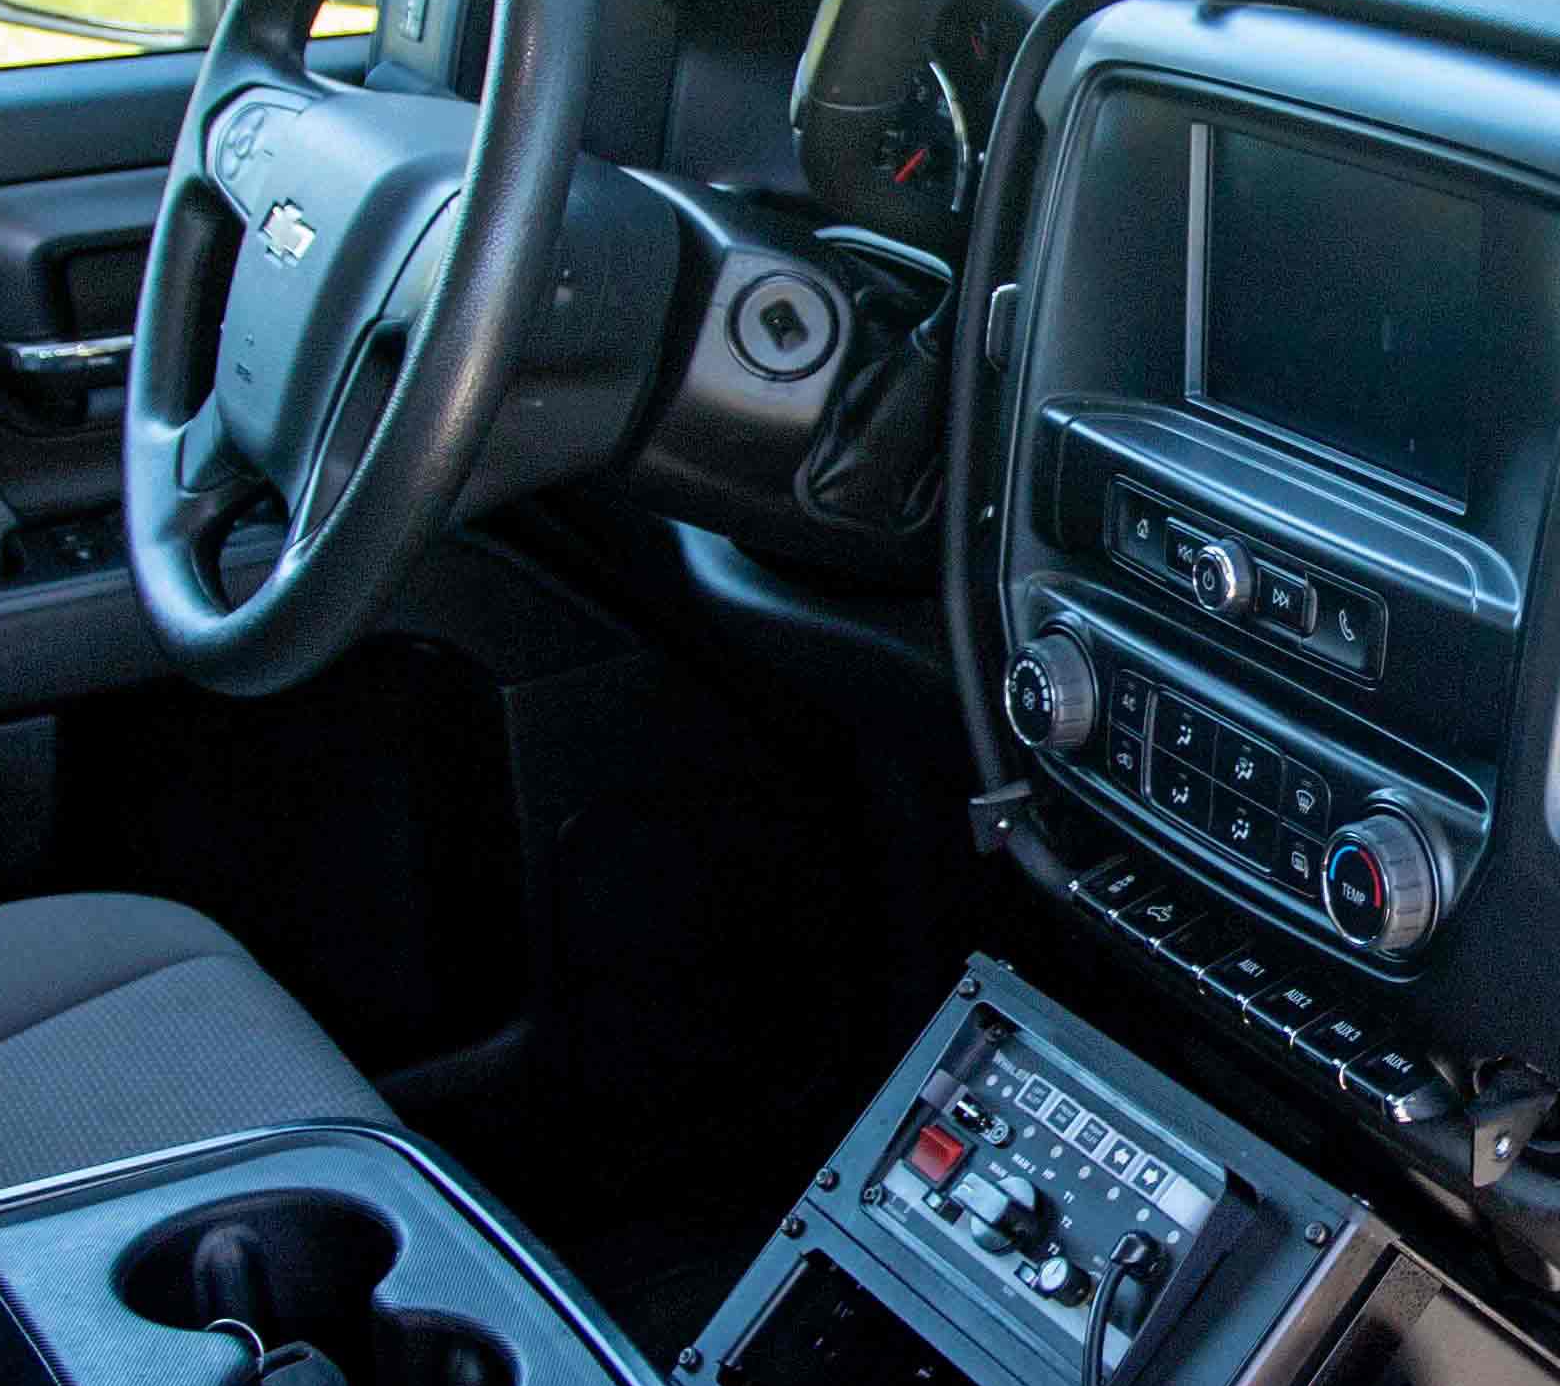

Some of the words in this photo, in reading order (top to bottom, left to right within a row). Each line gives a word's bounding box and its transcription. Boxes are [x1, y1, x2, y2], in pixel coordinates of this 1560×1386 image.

[1342, 881, 1366, 906] TEMP
[1238, 958, 1257, 976] AUX
[1284, 988, 1306, 1006] AUX
[1331, 1020, 1354, 1038] AUX
[1382, 1052, 1406, 1071] AUX
